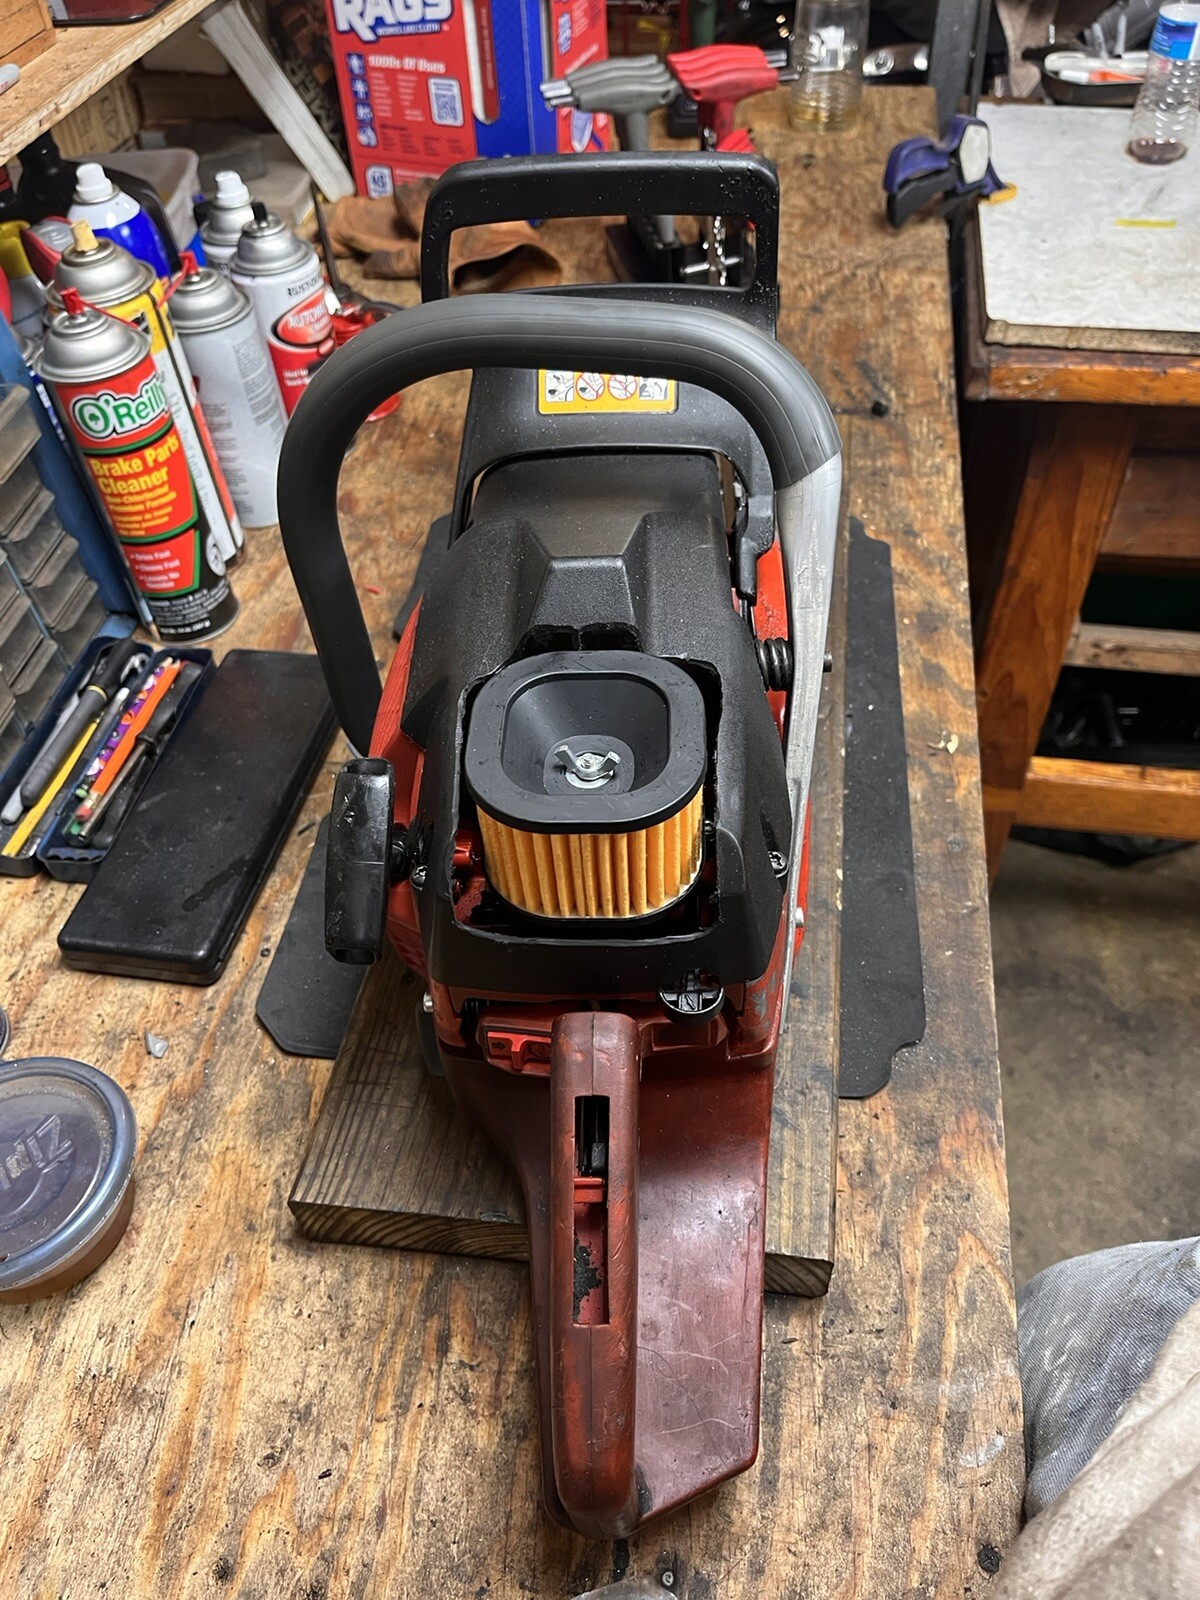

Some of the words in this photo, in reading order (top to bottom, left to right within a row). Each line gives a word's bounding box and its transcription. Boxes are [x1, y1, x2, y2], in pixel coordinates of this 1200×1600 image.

[89, 457, 143, 476] Brake
[144, 435, 179, 467] Parts
[98, 466, 168, 494] Cleaner
